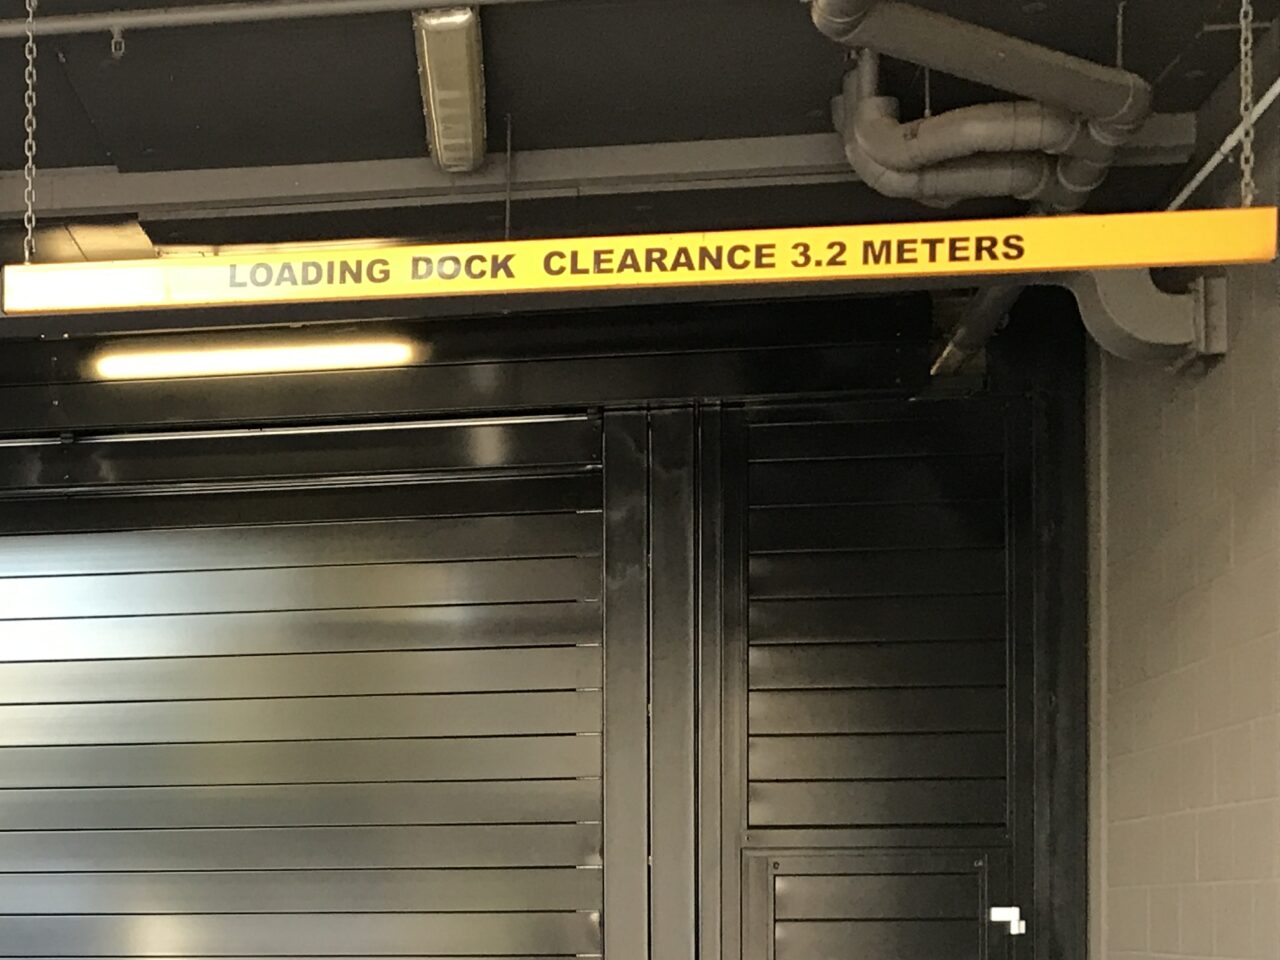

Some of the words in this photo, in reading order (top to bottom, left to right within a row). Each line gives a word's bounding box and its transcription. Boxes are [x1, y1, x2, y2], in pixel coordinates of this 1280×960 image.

[229, 258, 391, 288] LOADING
[411, 254, 516, 280] DOCK
[543, 243, 777, 276] CLEARANCE
[791, 241, 847, 268] 3.2
[862, 234, 1025, 266] METERS
